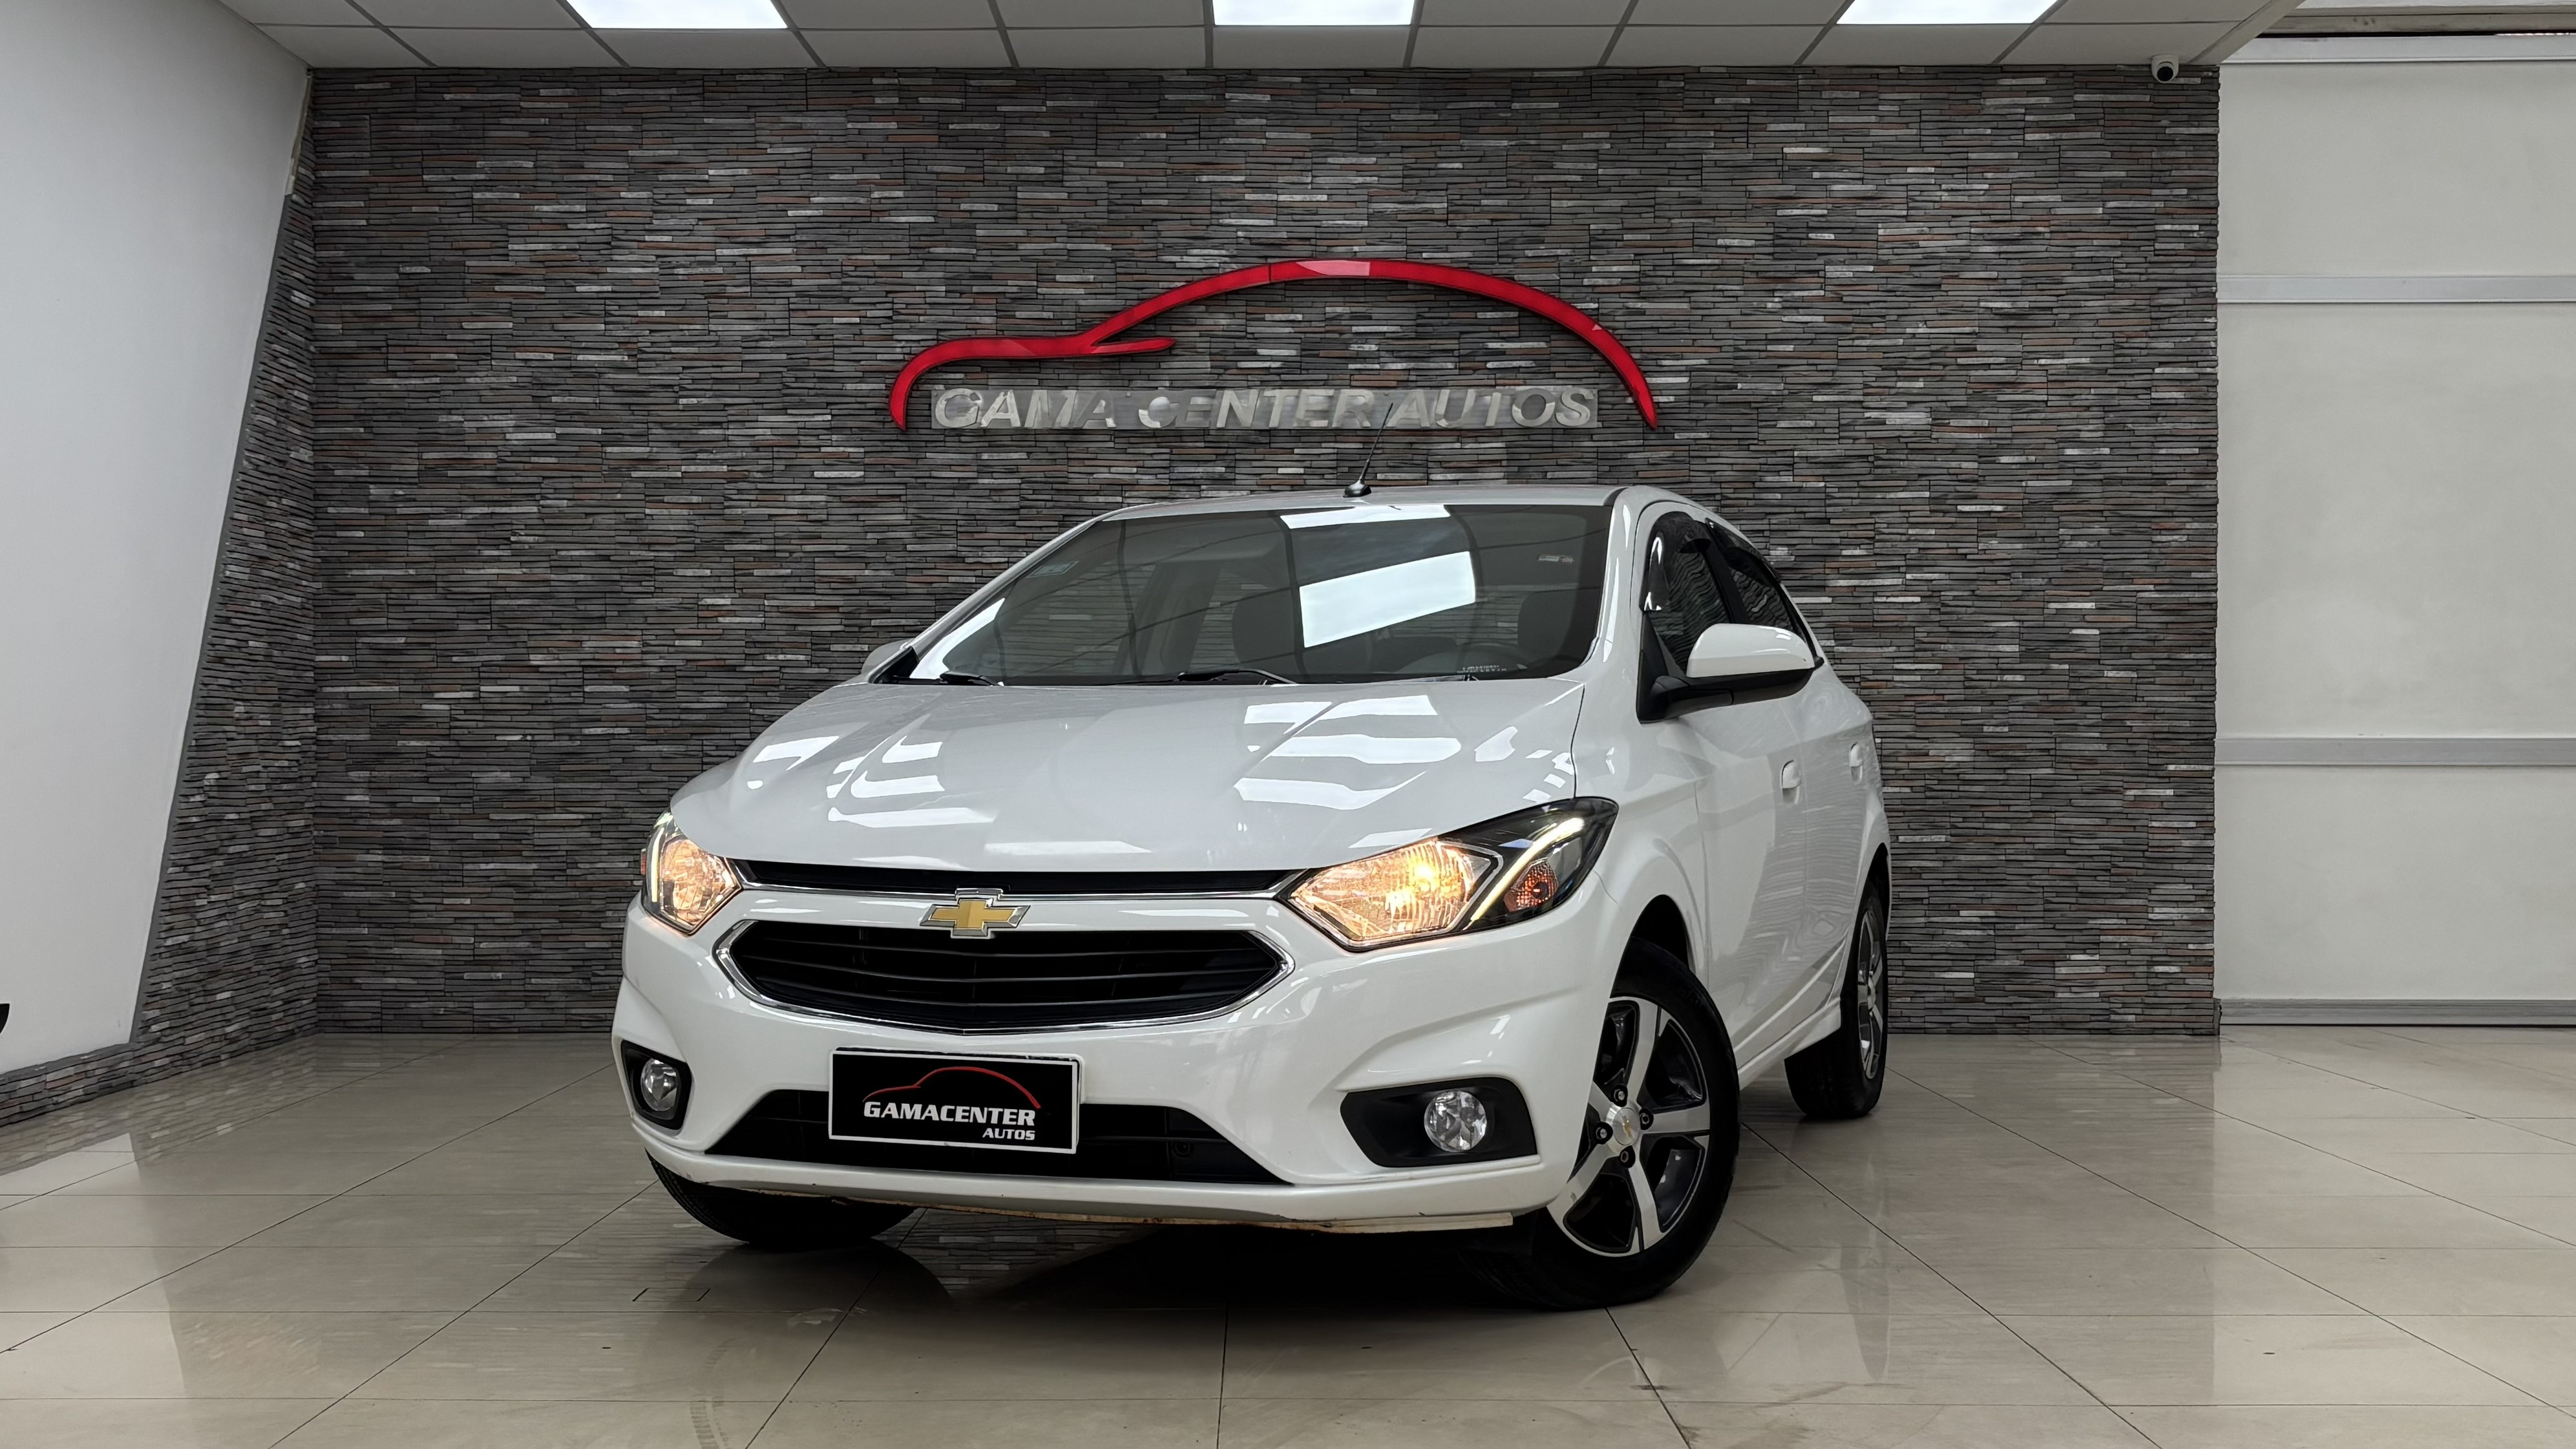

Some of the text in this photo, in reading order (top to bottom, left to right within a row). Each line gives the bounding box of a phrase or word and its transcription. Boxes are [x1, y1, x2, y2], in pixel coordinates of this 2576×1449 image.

[934, 388, 1595, 428] GAMA CENTER AUTOS
[863, 1101, 1036, 1126] GAMACENTER
[982, 1128, 1035, 1140] AUTOS
